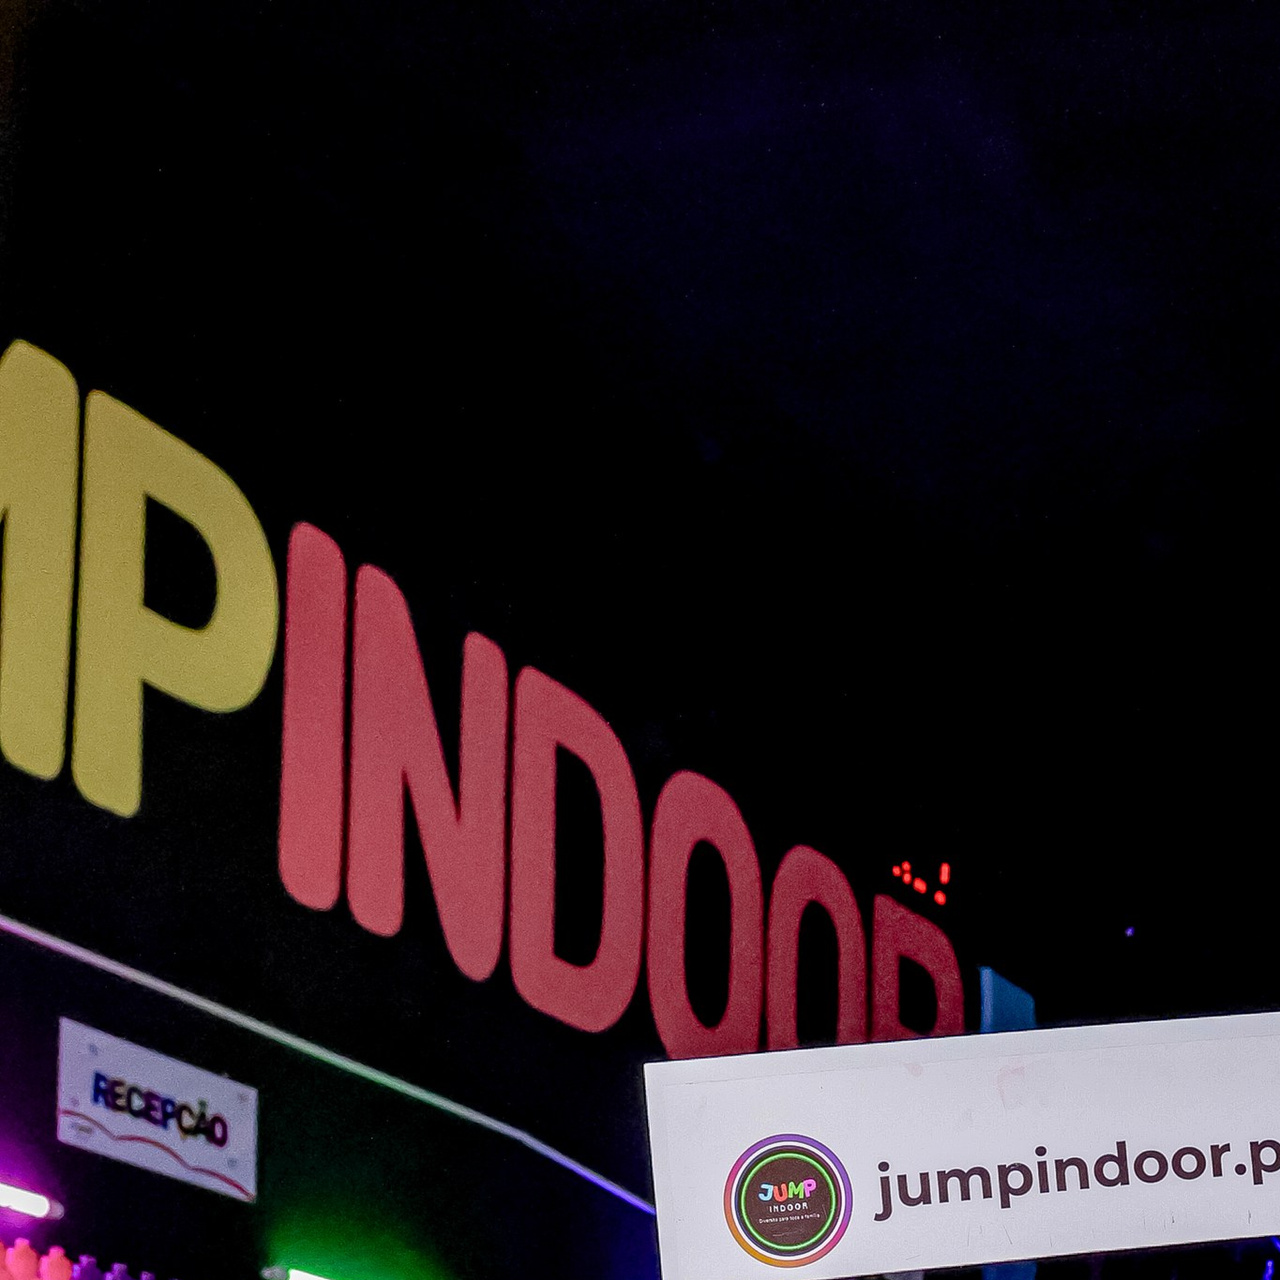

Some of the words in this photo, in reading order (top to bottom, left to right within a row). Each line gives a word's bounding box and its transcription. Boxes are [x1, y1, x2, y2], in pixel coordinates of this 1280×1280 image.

[279, 521, 966, 1060] INDOOR
[91, 1070, 229, 1148] RECEPÇÃO
[758, 1178, 817, 1202] JUMP
[769, 1202, 809, 1213] INDOOR
